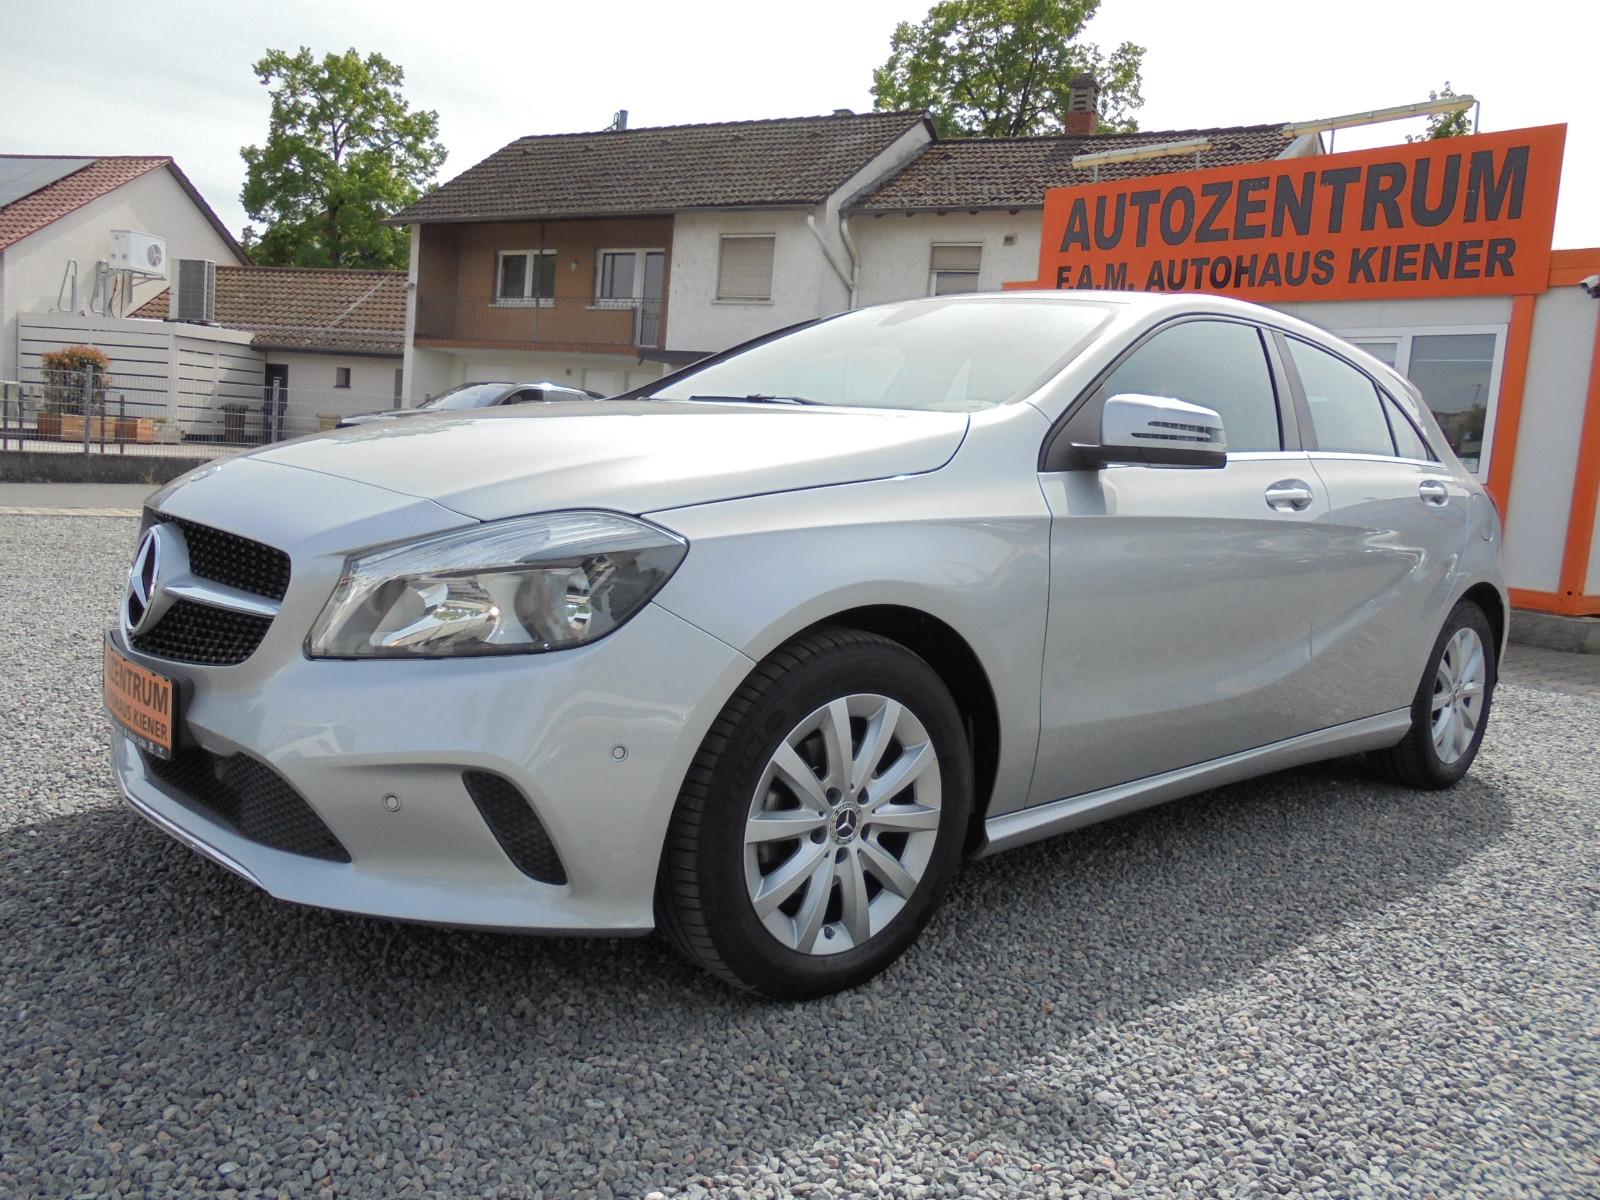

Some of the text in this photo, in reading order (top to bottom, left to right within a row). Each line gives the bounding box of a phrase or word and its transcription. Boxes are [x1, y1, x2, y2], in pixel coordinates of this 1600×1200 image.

[1059, 145, 1530, 253] AUTOZENTRUM
[1144, 249, 1335, 291] AUTOHAUS
[1348, 237, 1516, 284] KIENER
[132, 708, 168, 742] KIENER
